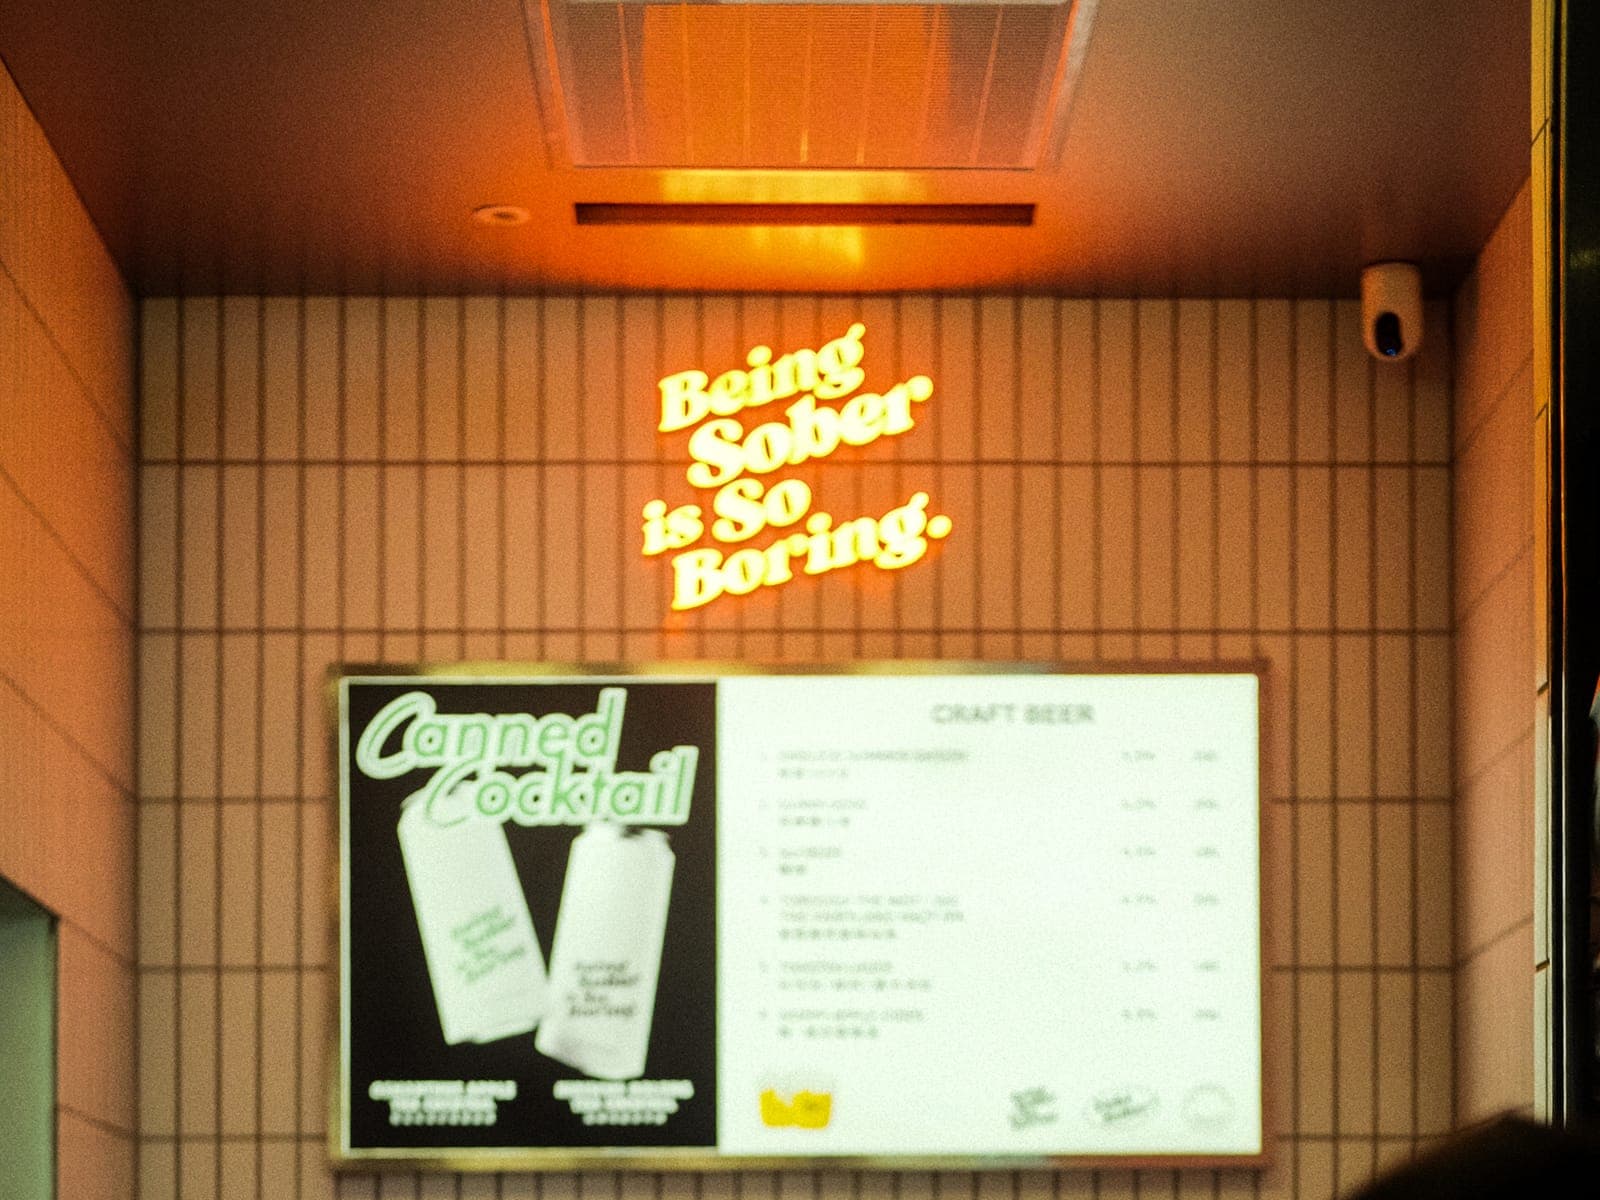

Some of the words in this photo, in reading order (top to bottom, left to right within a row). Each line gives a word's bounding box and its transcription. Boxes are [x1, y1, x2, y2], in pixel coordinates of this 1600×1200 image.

[658, 322, 866, 432] Being
[686, 375, 934, 488] Sober
[642, 499, 704, 555] is
[711, 478, 812, 542] So
[671, 492, 952, 610] Boring.
[358, 689, 626, 777] Canned
[930, 702, 1016, 725] CRAFT
[1023, 702, 1095, 725] BEER
[424, 746, 698, 827] Cocktail
